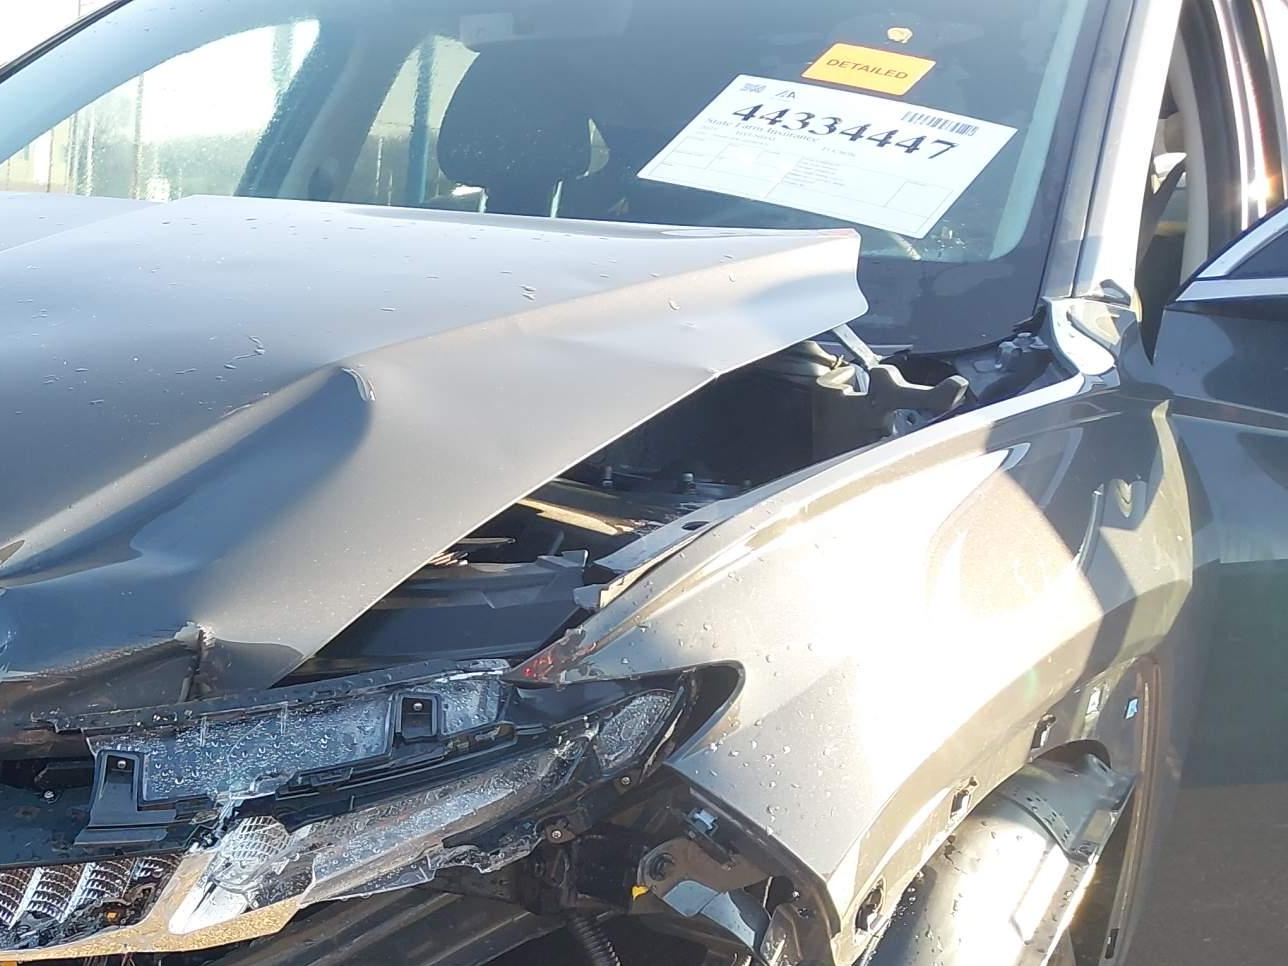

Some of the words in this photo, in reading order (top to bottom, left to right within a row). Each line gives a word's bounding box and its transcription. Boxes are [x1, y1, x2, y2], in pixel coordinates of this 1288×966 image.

[826, 59, 909, 80] DETAILED
[707, 117, 734, 127] State
[735, 120, 764, 133] Farm
[766, 127, 820, 143] Insurance
[732, 103, 958, 159] 44334447
